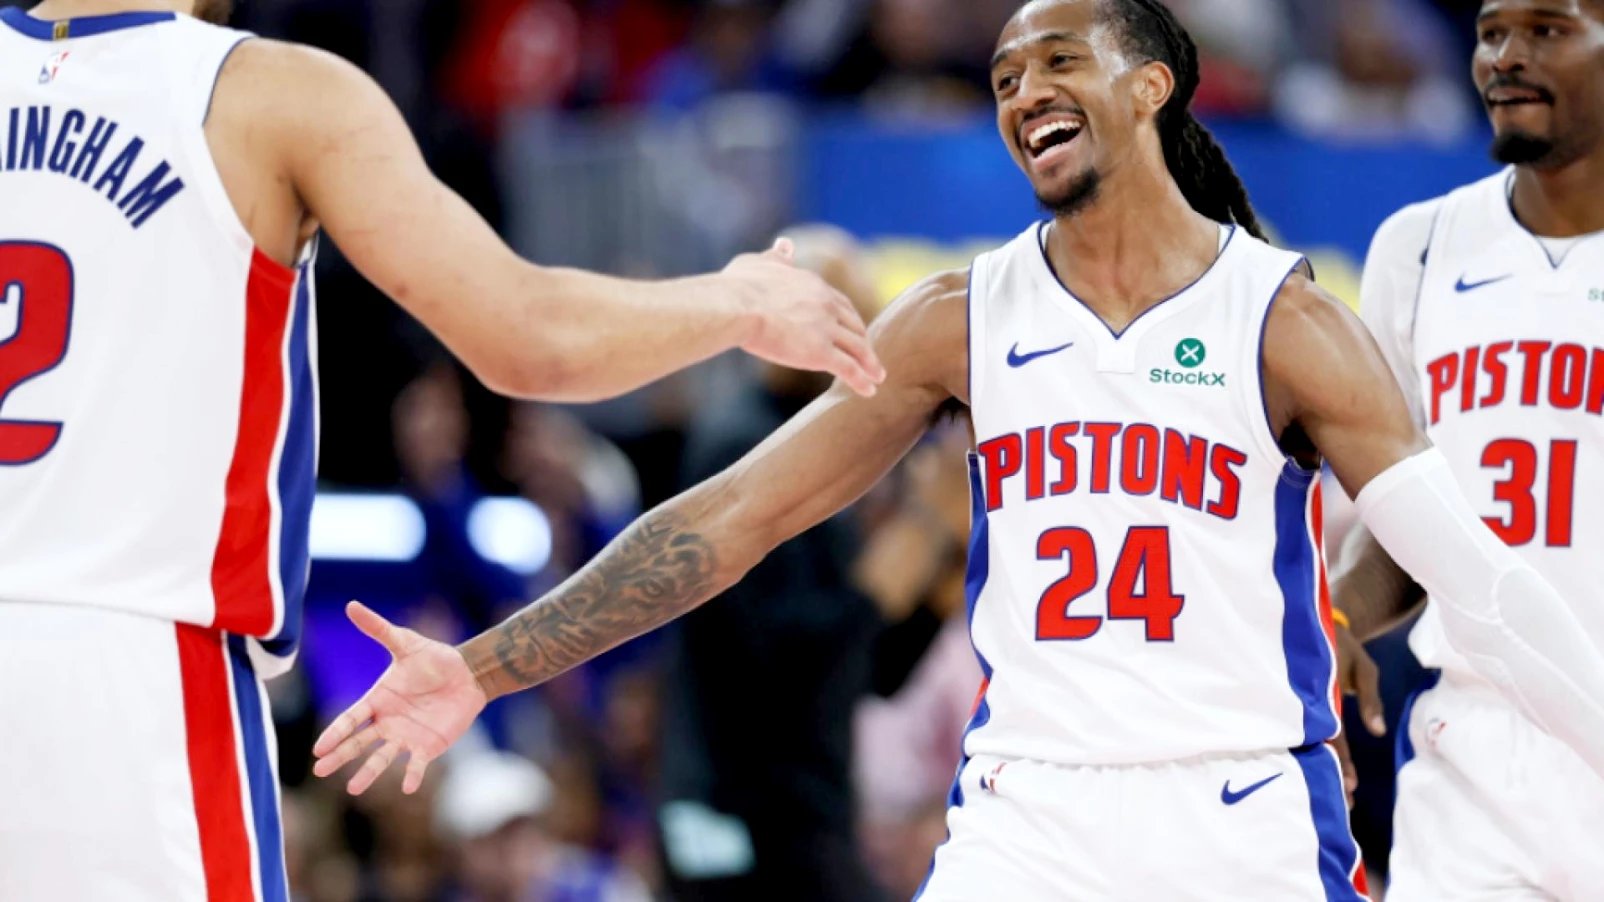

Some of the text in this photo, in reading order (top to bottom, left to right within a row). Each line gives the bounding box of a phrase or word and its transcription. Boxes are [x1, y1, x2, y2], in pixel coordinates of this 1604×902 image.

[0, 105, 185, 229] INGHAM
[0, 239, 74, 466] 2
[1149, 368, 1226, 387] StockX
[977, 420, 1248, 521] PISTONS
[1480, 437, 1578, 548] 31
[1035, 525, 1186, 642] 24
